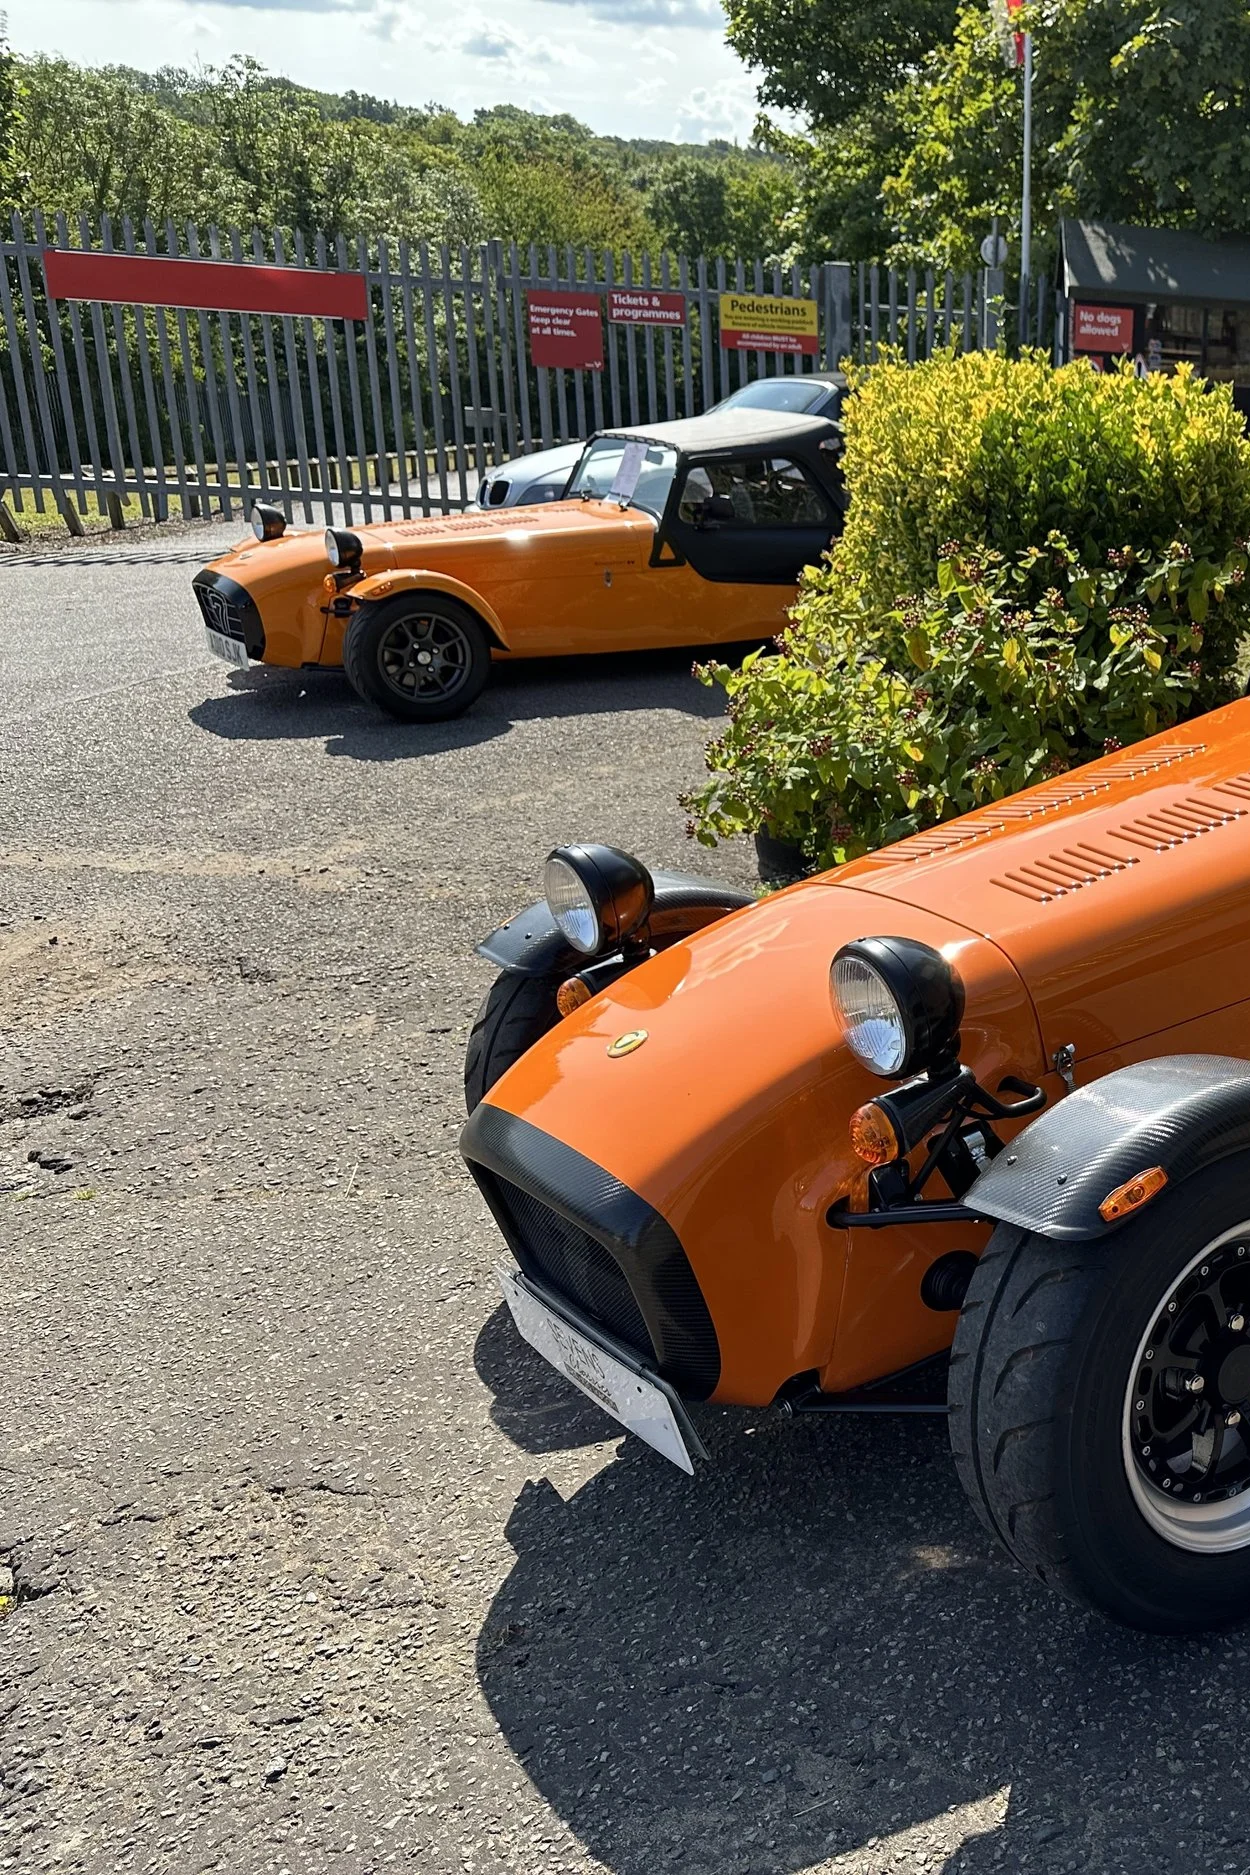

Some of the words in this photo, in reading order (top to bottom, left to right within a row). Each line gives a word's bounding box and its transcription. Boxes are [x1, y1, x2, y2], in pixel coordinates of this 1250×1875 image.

[612, 293, 649, 307] Tickets
[651, 296, 660, 307] &
[529, 304, 574, 317] Emergency
[575, 307, 599, 318] Gates
[612, 307, 681, 321] programmes
[730, 299, 807, 317] Pedestrians
[530, 315, 551, 325] Keep
[551, 316, 571, 326] clear
[1079, 311, 1095, 322] No
[1096, 311, 1122, 326] dogs
[531, 327, 541, 335] at
[541, 327, 552, 335] all
[553, 327, 577, 337] times.
[1079, 323, 1119, 336] allowed
[546, 1317, 606, 1379] SEVENS
